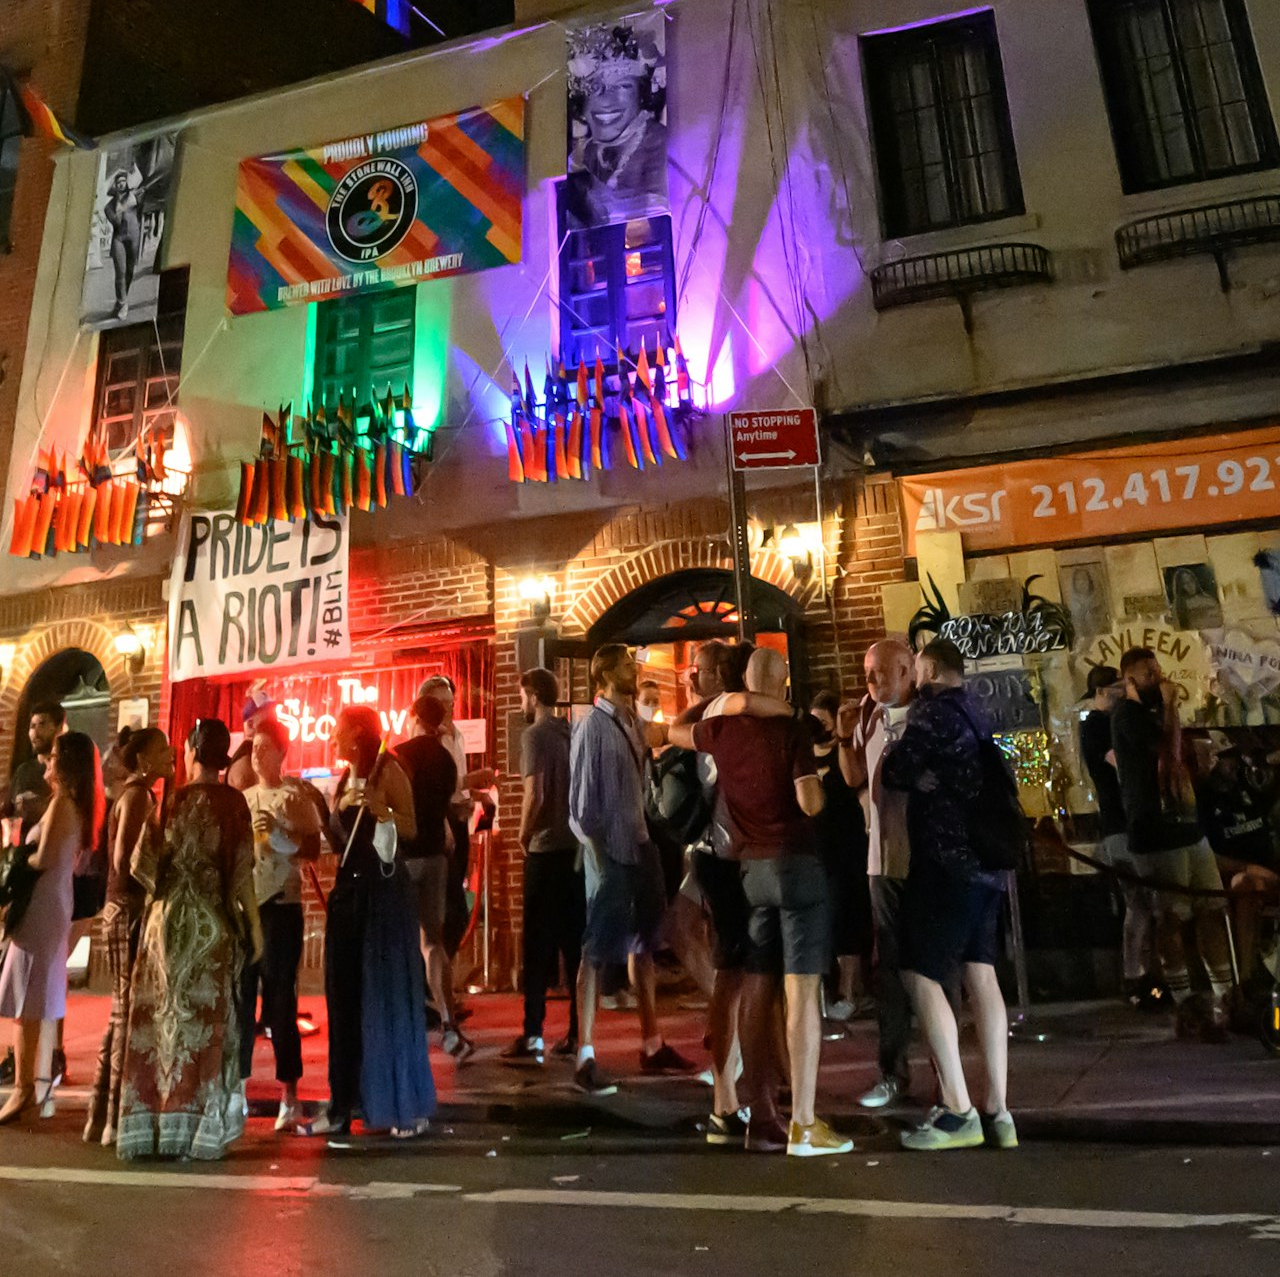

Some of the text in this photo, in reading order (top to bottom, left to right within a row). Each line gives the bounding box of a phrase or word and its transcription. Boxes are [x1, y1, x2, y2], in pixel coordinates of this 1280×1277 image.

[323, 122, 428, 164] PROUDLY POURING
[332, 162, 415, 208] THE STONEWALL INN
[361, 247, 379, 259] IPA
[277, 282, 309, 301] BREWED
[310, 278, 330, 295] WITH
[331, 275, 352, 291] LOVE
[353, 272, 365, 287] BY
[365, 269, 379, 285] THE
[424, 253, 464, 273] BREWERY
[734, 415, 801, 428] NO STOPPING
[736, 430, 778, 444] Anytime
[184, 513, 343, 582] PRIDE IS
[176, 576, 322, 669] A RIOT!
[322, 569, 343, 648] #BLM
[337, 678, 378, 704] The
